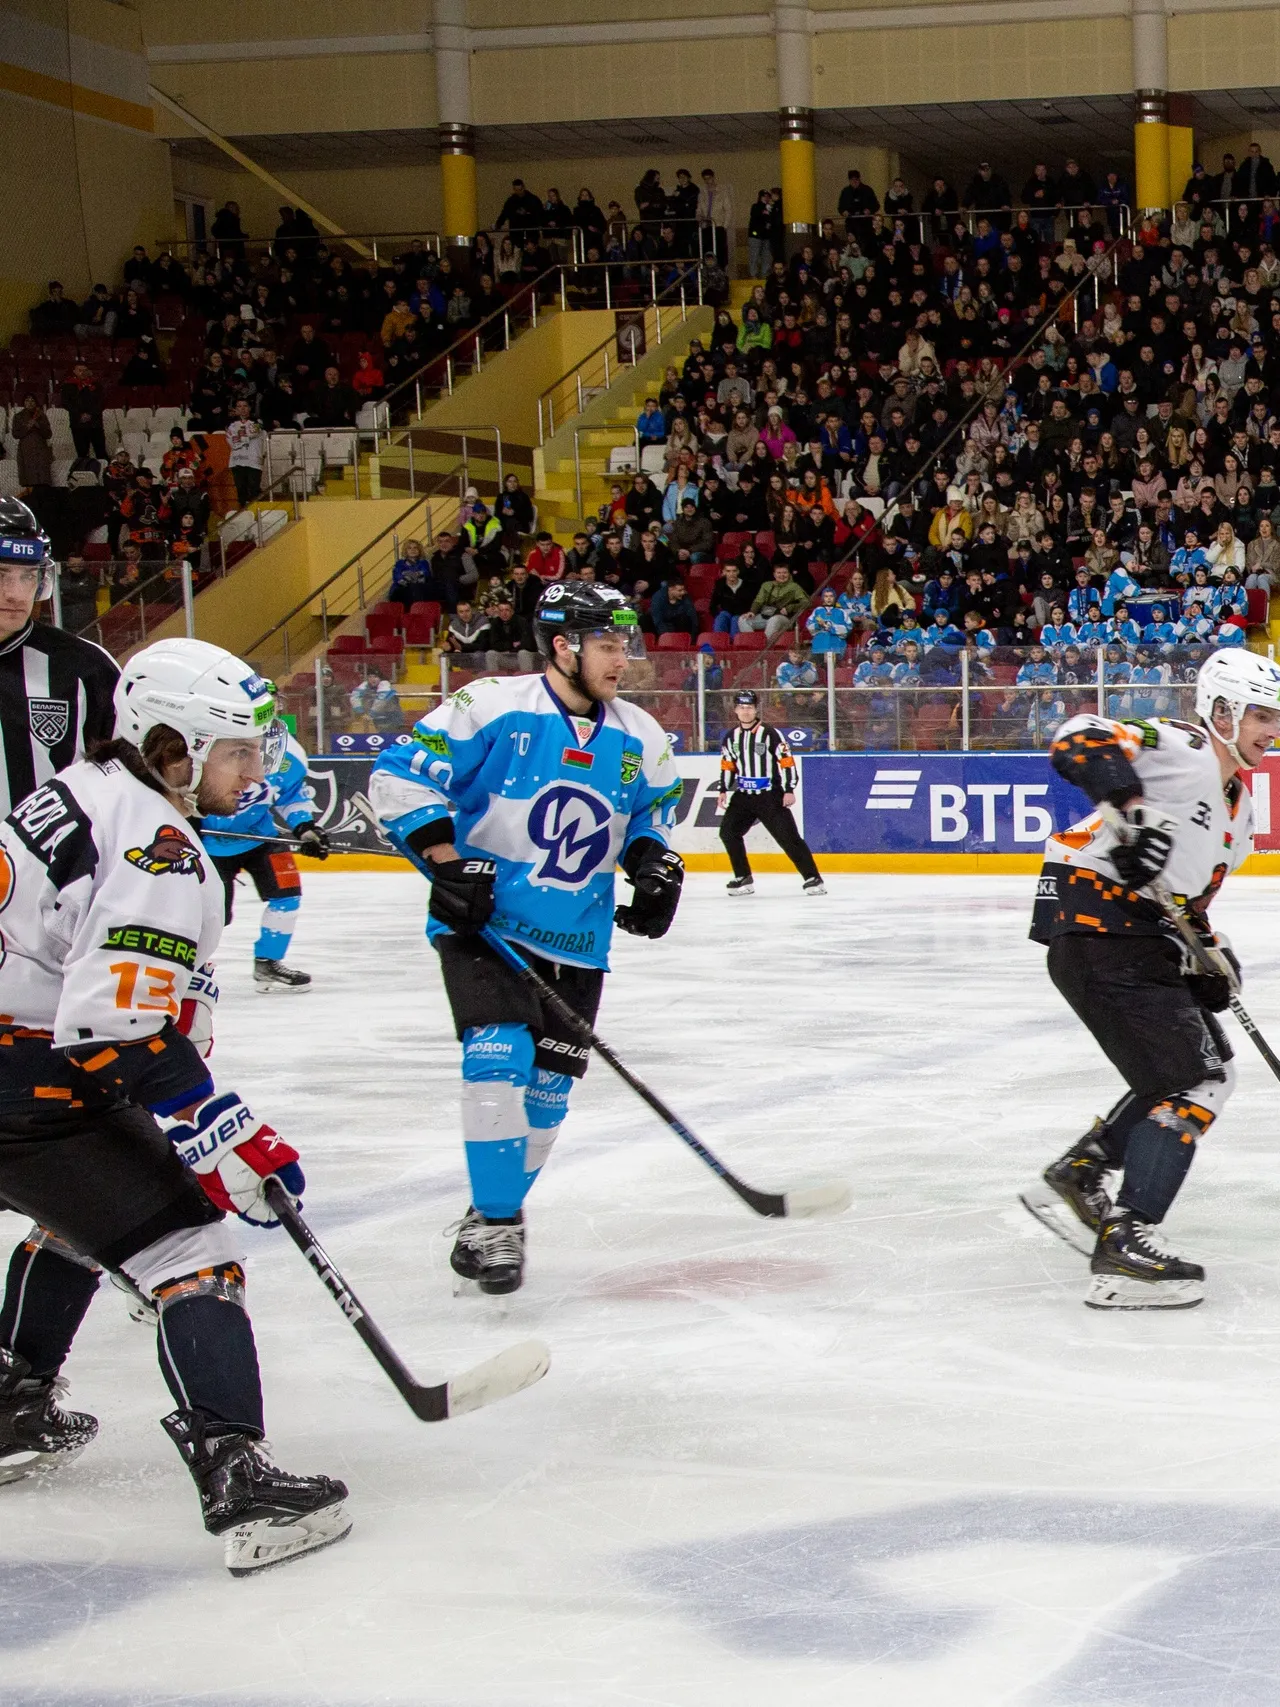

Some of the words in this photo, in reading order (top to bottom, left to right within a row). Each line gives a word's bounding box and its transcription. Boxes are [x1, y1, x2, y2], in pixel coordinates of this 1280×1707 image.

[13, 543, 34, 555] ВТБ
[32, 703, 66, 712] БЕЛАРУСЬ
[509, 731, 531, 757] 10
[930, 784, 1054, 843] ВТБ
[109, 961, 179, 1017] 13
